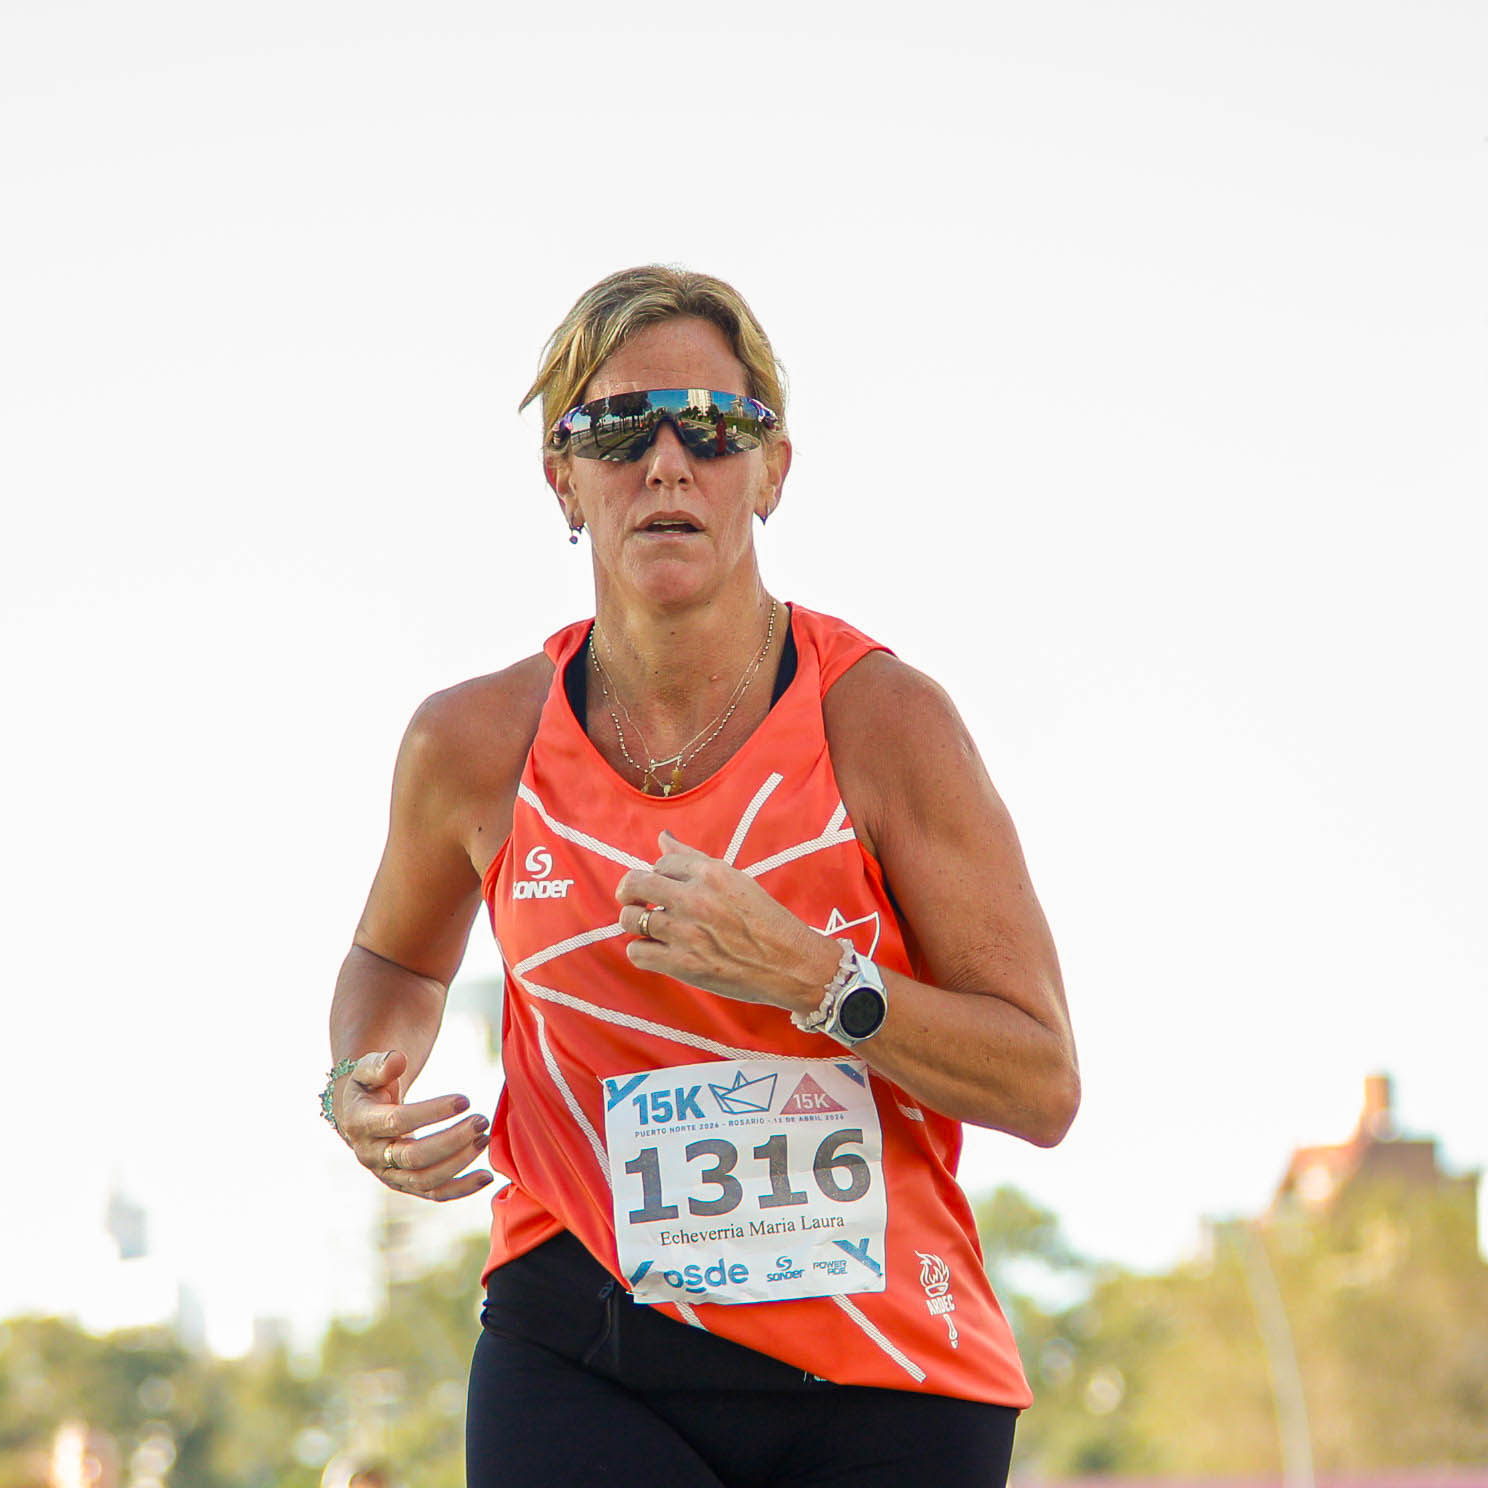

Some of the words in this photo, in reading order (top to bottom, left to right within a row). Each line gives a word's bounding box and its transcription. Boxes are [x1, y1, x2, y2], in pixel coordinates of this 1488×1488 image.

[632, 1085, 706, 1125] 15K
[793, 1093, 830, 1109] 15K
[635, 1127, 667, 1138] PUERTO
[670, 1124, 696, 1135] NORTE
[699, 1121, 719, 1130] 2026
[728, 1118, 765, 1127] ROSARIO
[624, 1128, 872, 1224] 1316
[660, 1223, 744, 1246] Echeverria
[749, 1216, 796, 1237] Maria
[801, 1215, 845, 1231] Laura
[664, 1257, 749, 1288] osde
[813, 1260, 847, 1270] POWER
[925, 1294, 956, 1316] ARDEC
